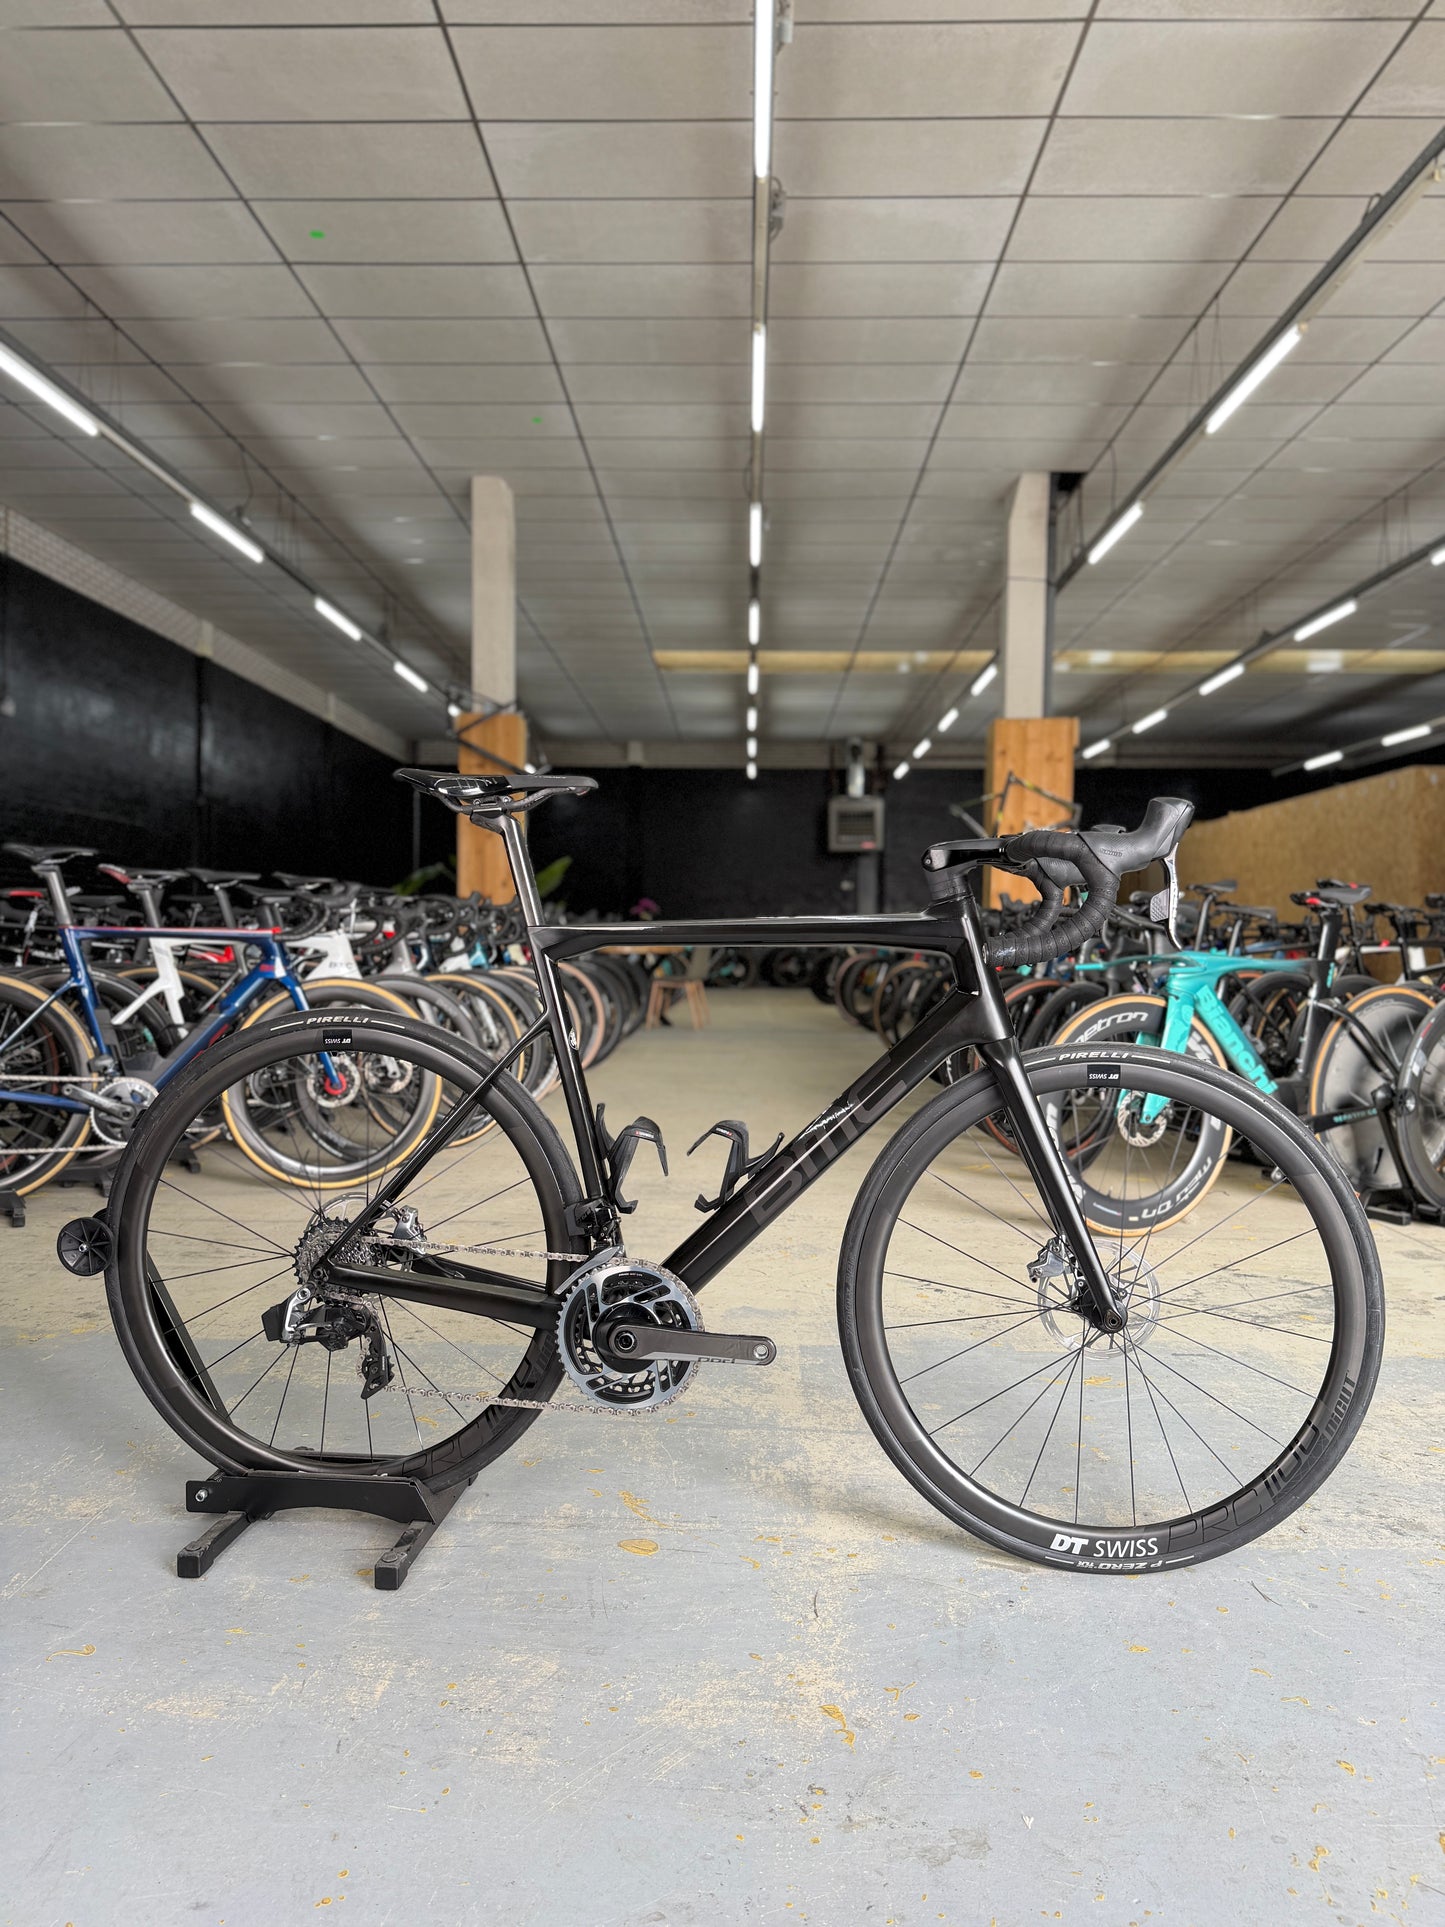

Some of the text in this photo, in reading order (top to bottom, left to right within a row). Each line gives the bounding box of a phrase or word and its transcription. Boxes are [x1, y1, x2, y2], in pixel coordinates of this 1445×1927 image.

[306, 1016, 369, 1024] PIRELLI
[1194, 985, 1279, 1095] Bianchi
[1059, 1051, 1129, 1060] PIRELLI
[744, 1055, 907, 1226] BMC
[1167, 1488, 1262, 1554] PRC
[1050, 1533, 1159, 1558] DT SWISS
[1098, 1562, 1148, 1570] ZERO
[1150, 1560, 1163, 1568] P
